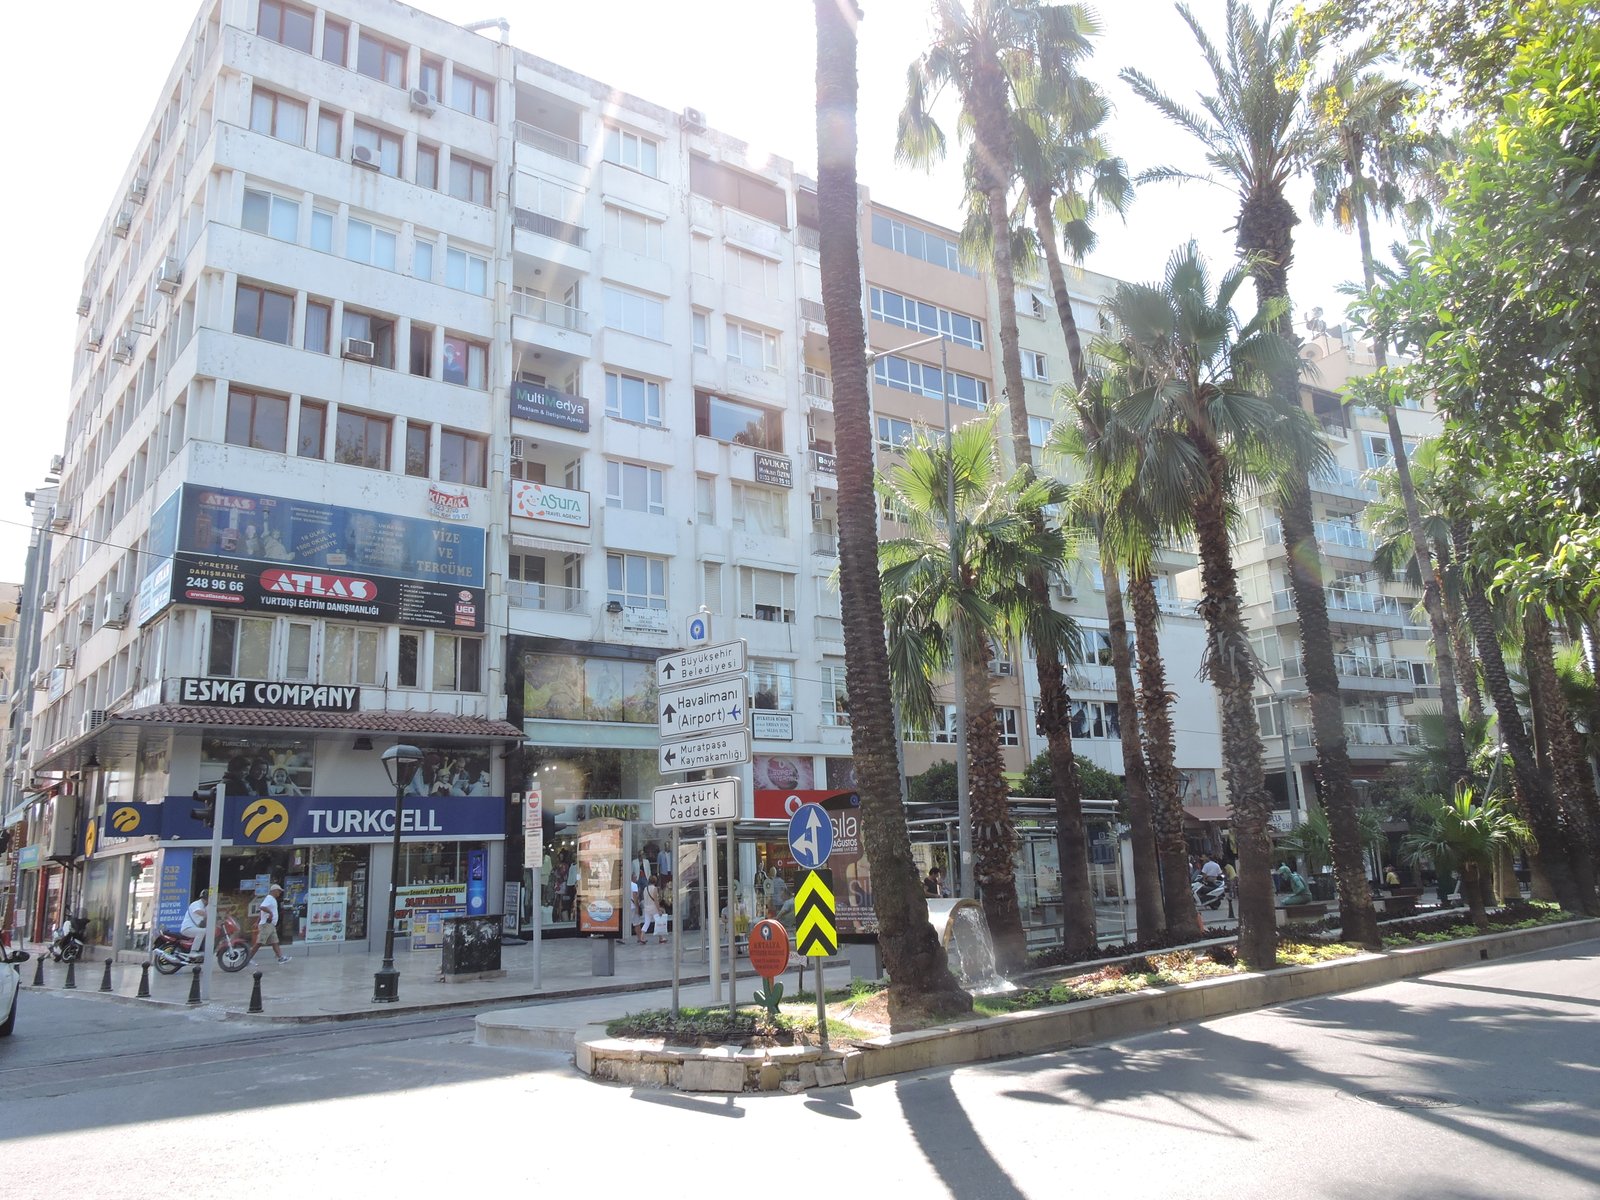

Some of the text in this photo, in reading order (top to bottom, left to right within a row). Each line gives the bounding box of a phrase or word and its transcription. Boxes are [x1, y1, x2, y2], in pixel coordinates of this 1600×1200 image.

[516, 388, 585, 415] MultiMedya
[517, 404, 540, 414] Reklam
[759, 457, 790, 471] AVUKAT
[545, 510, 582, 521] TRAVEL AGENCY
[431, 527, 461, 545] VİZE
[437, 547, 454, 559] VE
[189, 568, 246, 580] DANIŞMANLIK
[416, 561, 473, 578] TERCÜME
[186, 577, 244, 592] 248 96 66
[270, 572, 368, 599] ATLAS
[260, 596, 379, 615] YURTDIŞI EĞİTİM DANIŞMANLIĞI
[456, 605, 475, 614] UED
[681, 649, 732, 667] Büyükşehir
[681, 659, 737, 678] Belediyesi
[184, 679, 356, 710] ESMA COMPANY
[677, 690, 738, 709] Havalimanı
[677, 706, 726, 730] (Airport)
[680, 740, 727, 754] Muratpaşa
[680, 750, 742, 766] Kaymakamlığı
[670, 788, 719, 806] Atatürk
[669, 804, 720, 820] Caddesi
[308, 809, 443, 833] TURKCELL
[833, 838, 858, 848] AĞUSTOS
